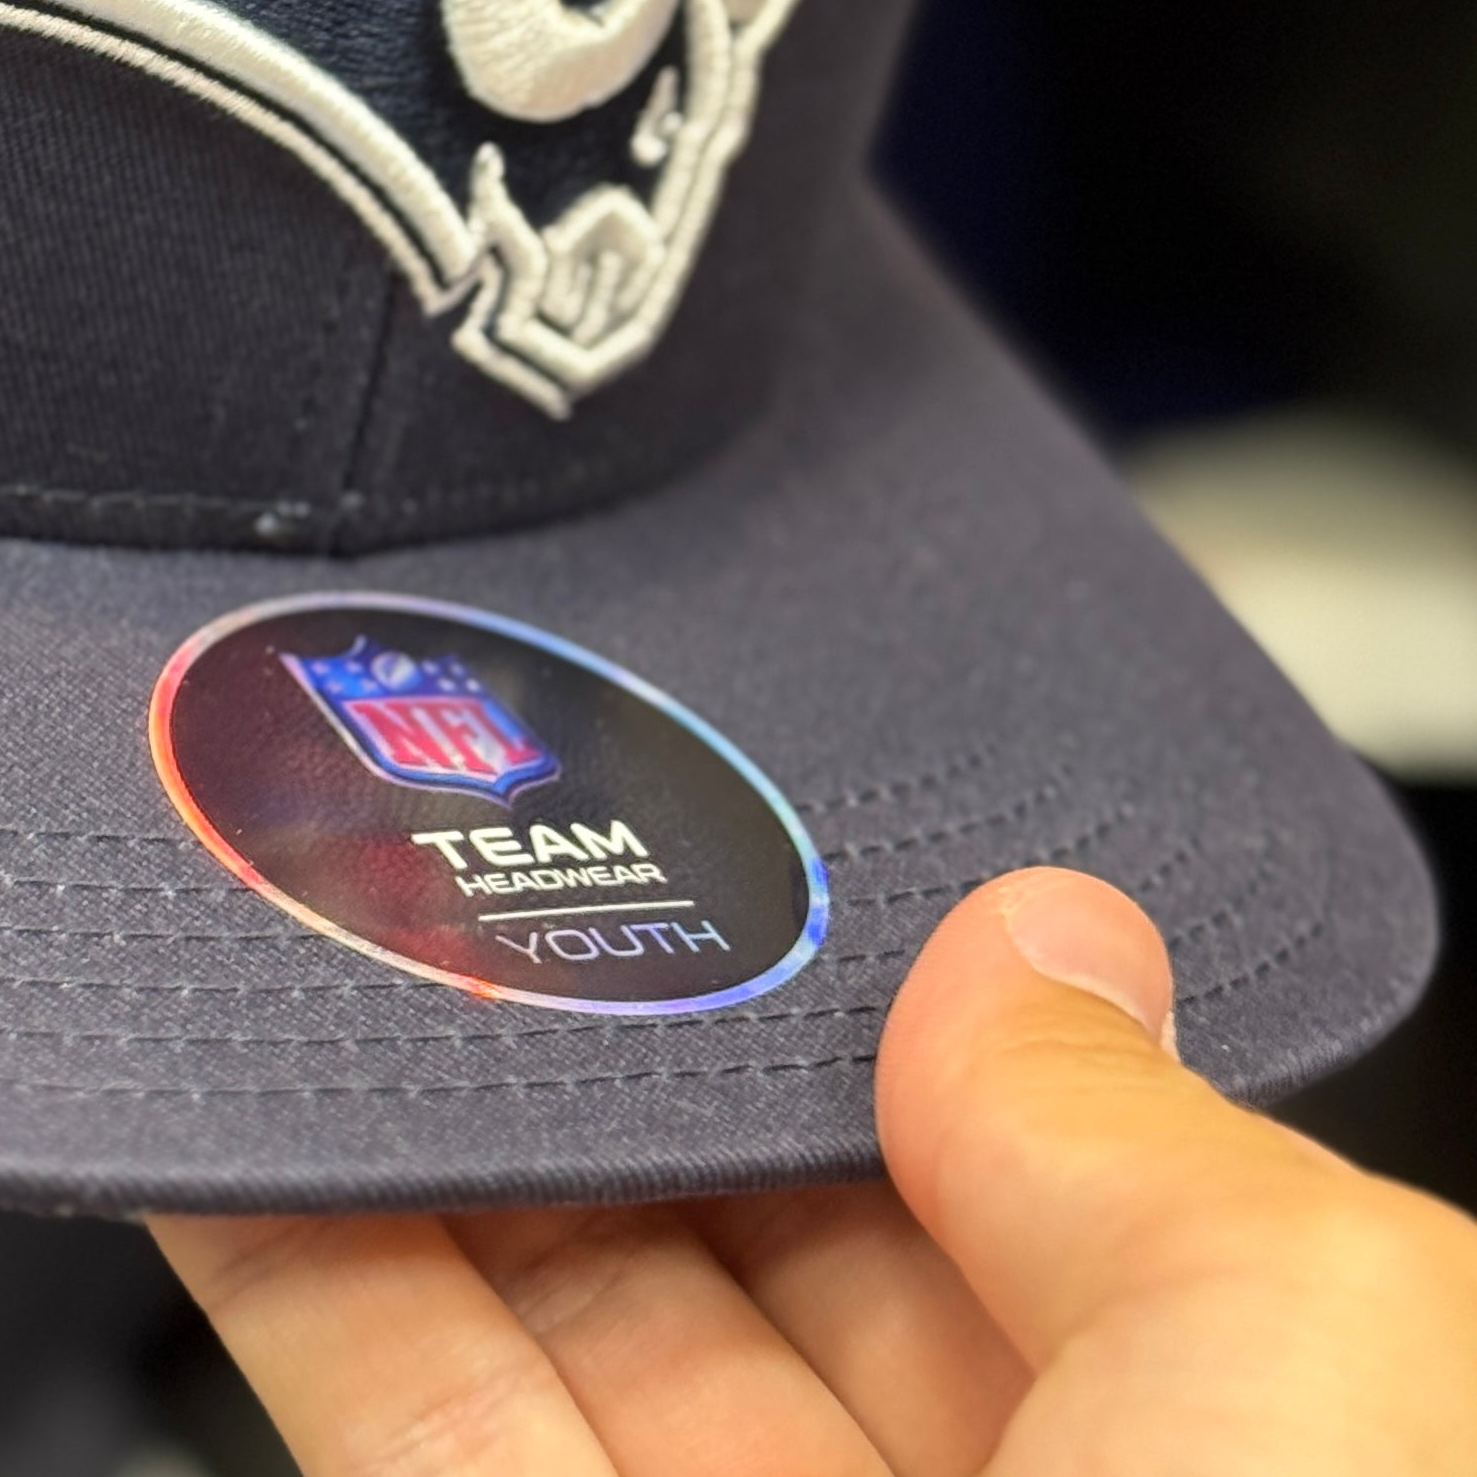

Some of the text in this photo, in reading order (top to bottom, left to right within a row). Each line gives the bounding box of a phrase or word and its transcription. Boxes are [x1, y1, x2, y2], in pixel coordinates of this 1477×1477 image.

[344, 698, 543, 777] NFL
[410, 819, 650, 870] TEAM
[454, 862, 669, 898] HEADWEAR
[494, 920, 732, 965] YOUTH
